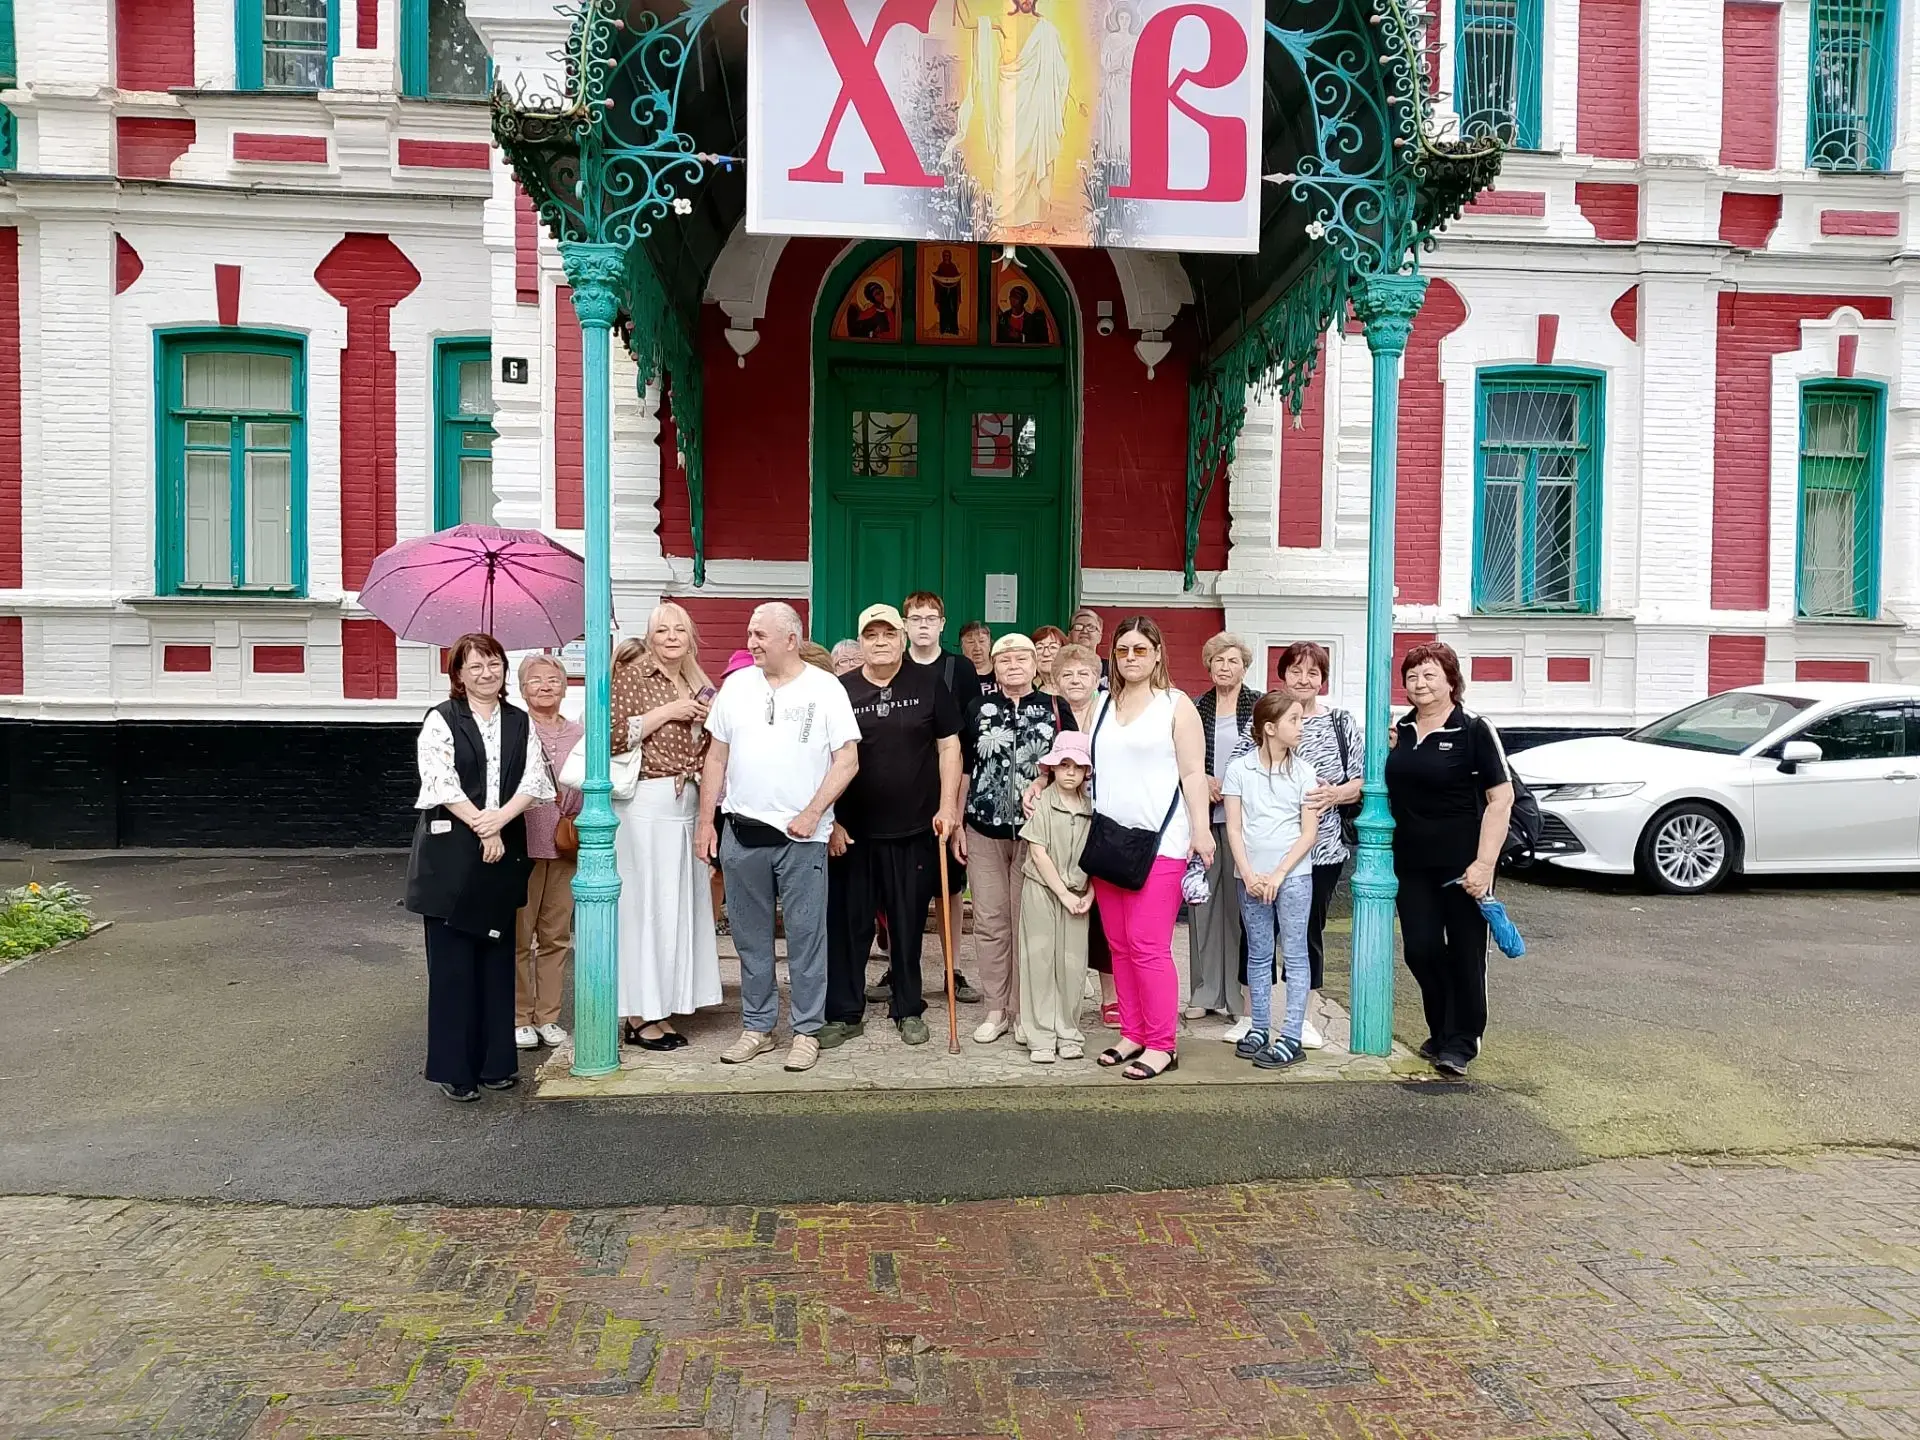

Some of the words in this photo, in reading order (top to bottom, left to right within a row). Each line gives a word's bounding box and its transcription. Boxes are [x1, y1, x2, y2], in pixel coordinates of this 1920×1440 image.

[788, 0, 944, 187] Х
[1109, 3, 1249, 202] В
[510, 361, 518, 379] 6
[890, 698, 919, 708] PLEIN
[801, 702, 816, 743] SUPERIOR
